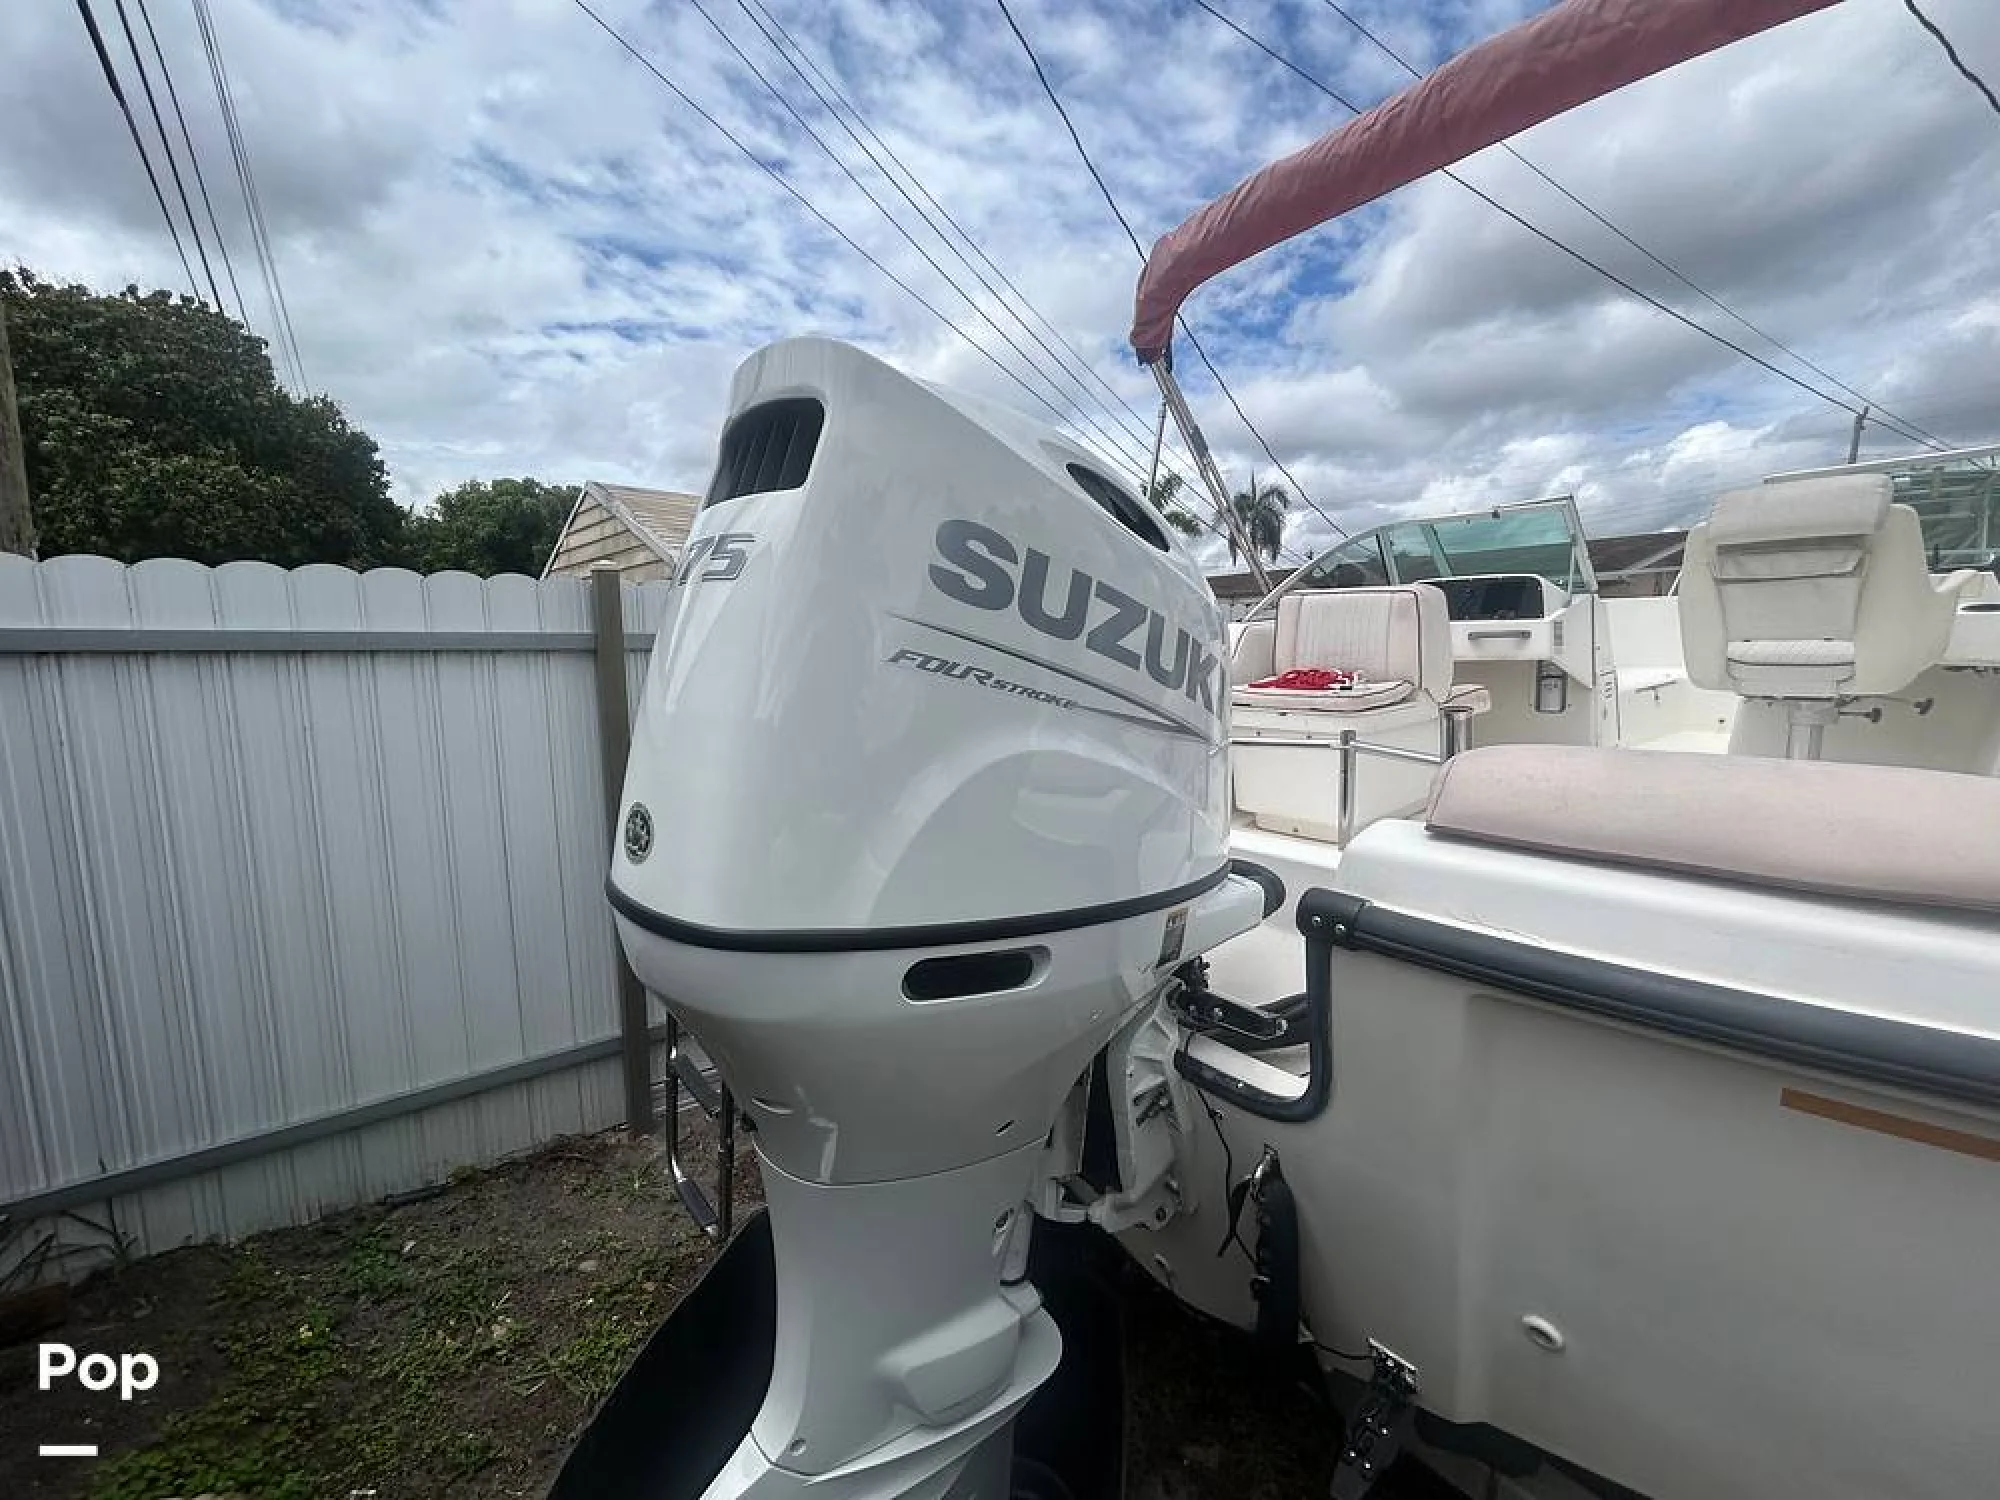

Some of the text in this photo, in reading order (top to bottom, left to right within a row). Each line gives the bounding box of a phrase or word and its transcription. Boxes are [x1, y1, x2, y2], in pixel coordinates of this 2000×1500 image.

[671, 533, 756, 588] 75
[884, 650, 1077, 709] FOUR STROKE
